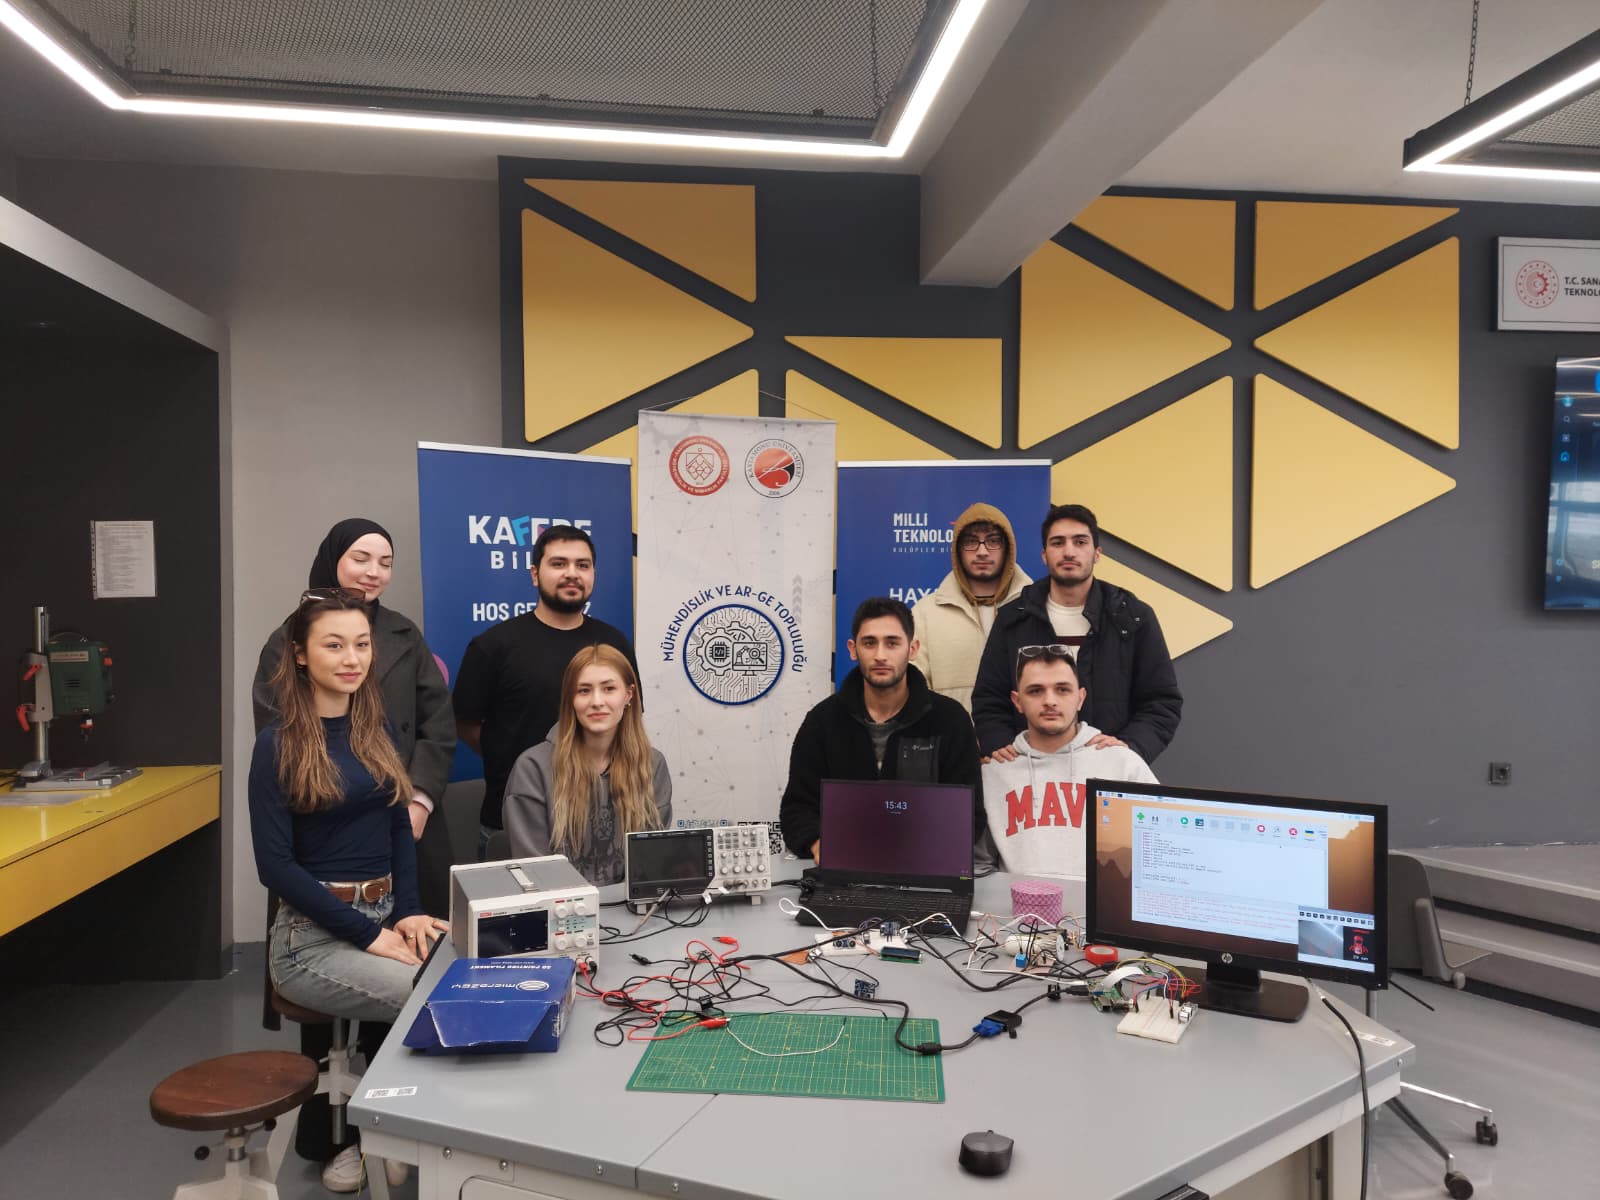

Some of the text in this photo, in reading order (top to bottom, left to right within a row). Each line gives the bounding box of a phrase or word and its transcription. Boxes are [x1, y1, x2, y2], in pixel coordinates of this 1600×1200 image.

[1564, 276, 1600, 286] T.C. SAN
[1564, 287, 1600, 297] TEKNOL
[893, 528, 954, 543] TEKNOLO
[660, 584, 808, 673] MÜHENDİSLİK VE AR-GE TOPLULUĞU
[885, 800, 908, 810] 15:43
[1006, 781, 1086, 838] MAV
